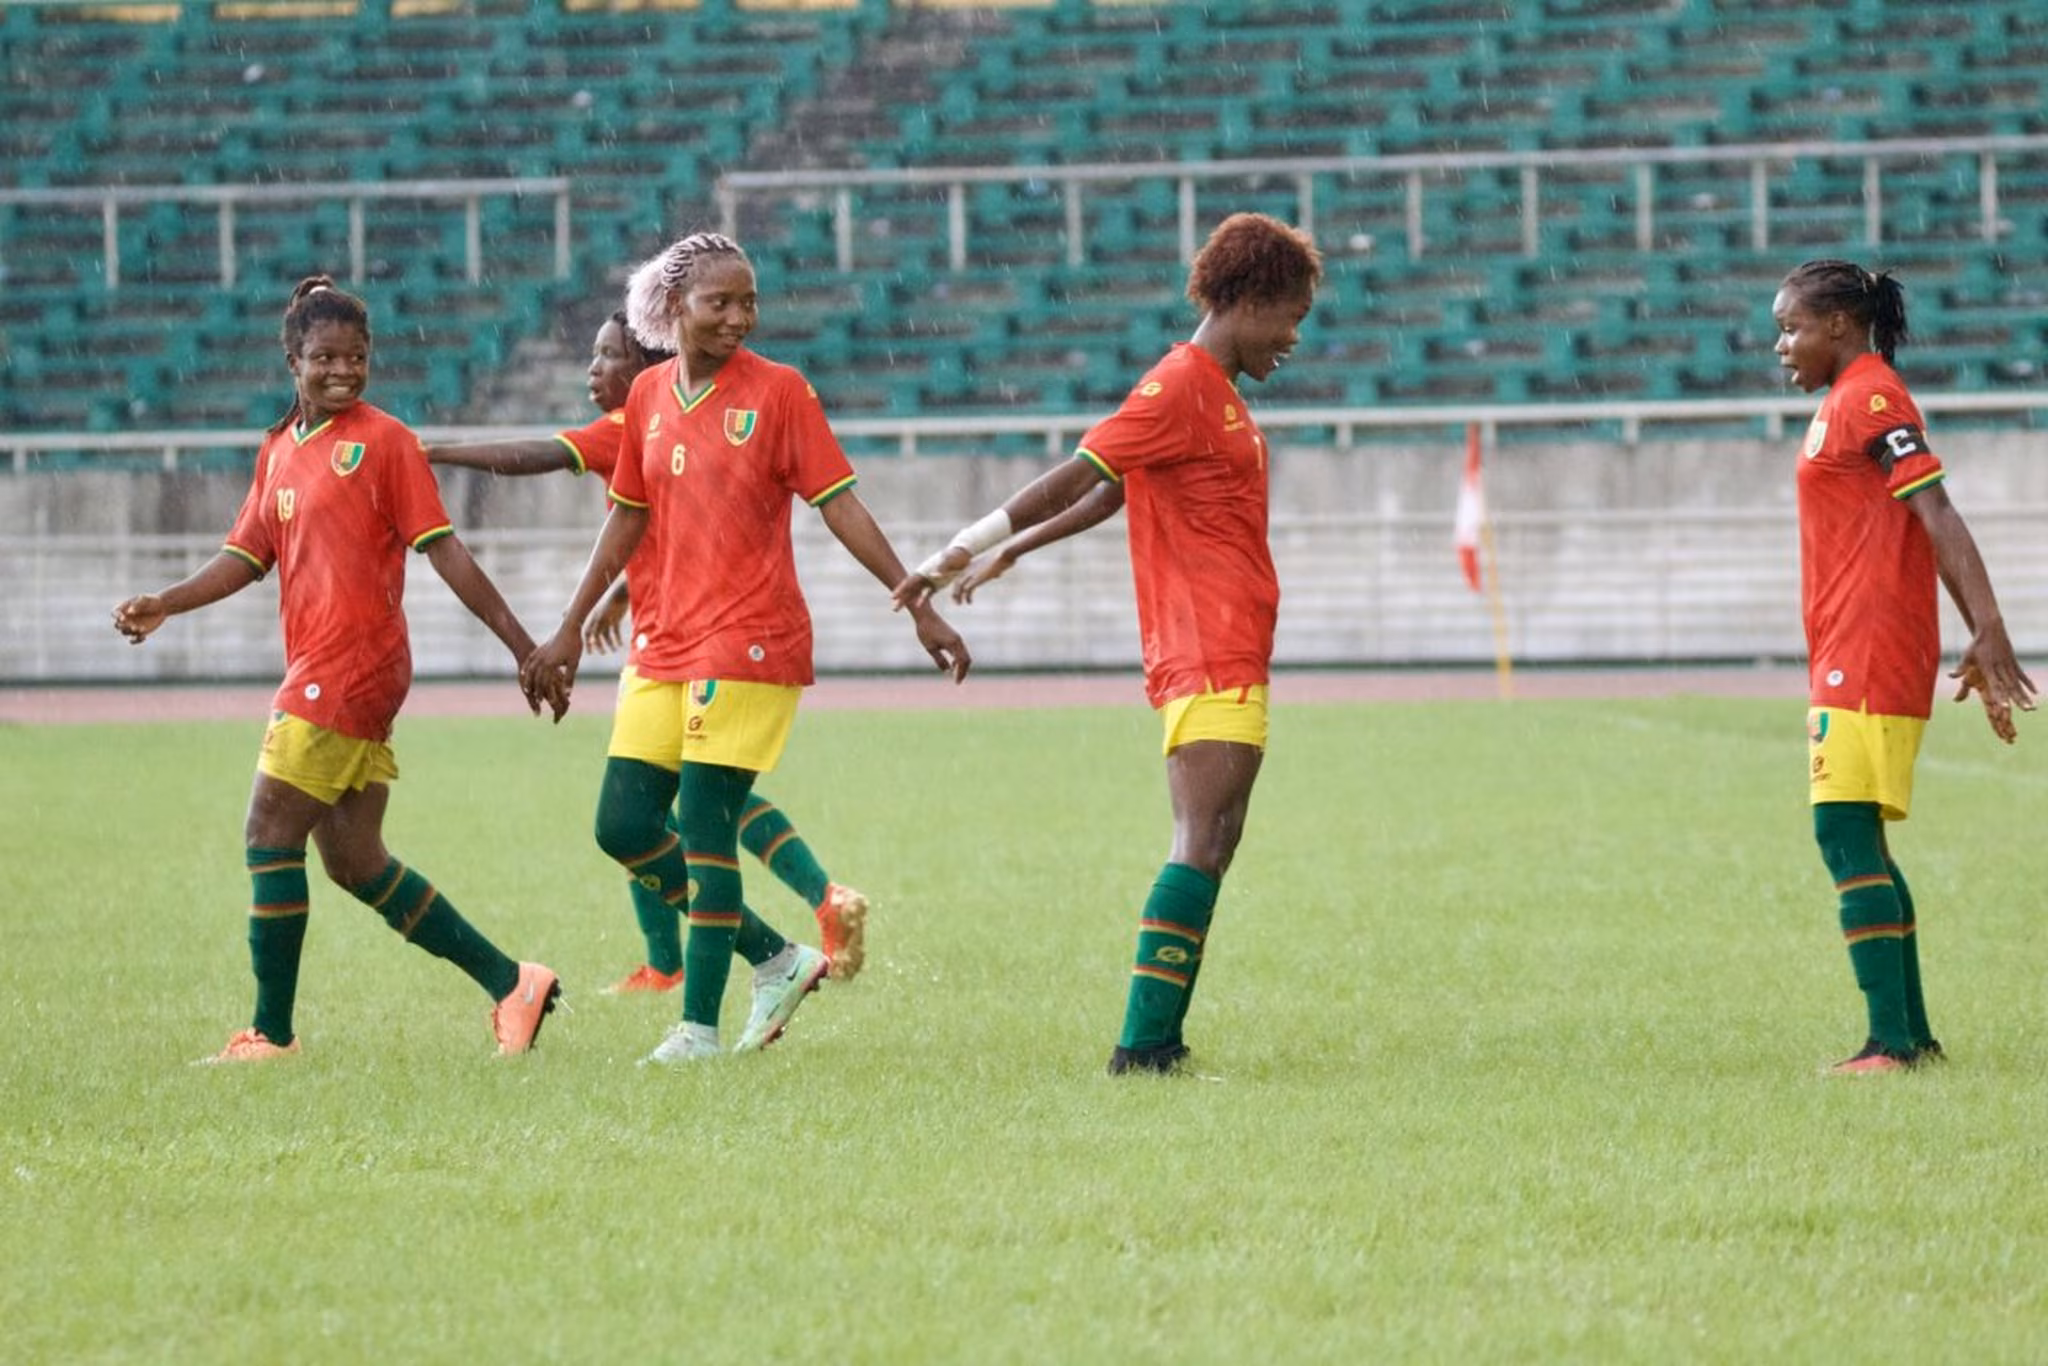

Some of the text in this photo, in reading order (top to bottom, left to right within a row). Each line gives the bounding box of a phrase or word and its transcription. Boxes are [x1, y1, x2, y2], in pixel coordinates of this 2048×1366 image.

[671, 443, 686, 476] 6
[1886, 429, 1917, 457] C
[277, 488, 295, 521] 19
